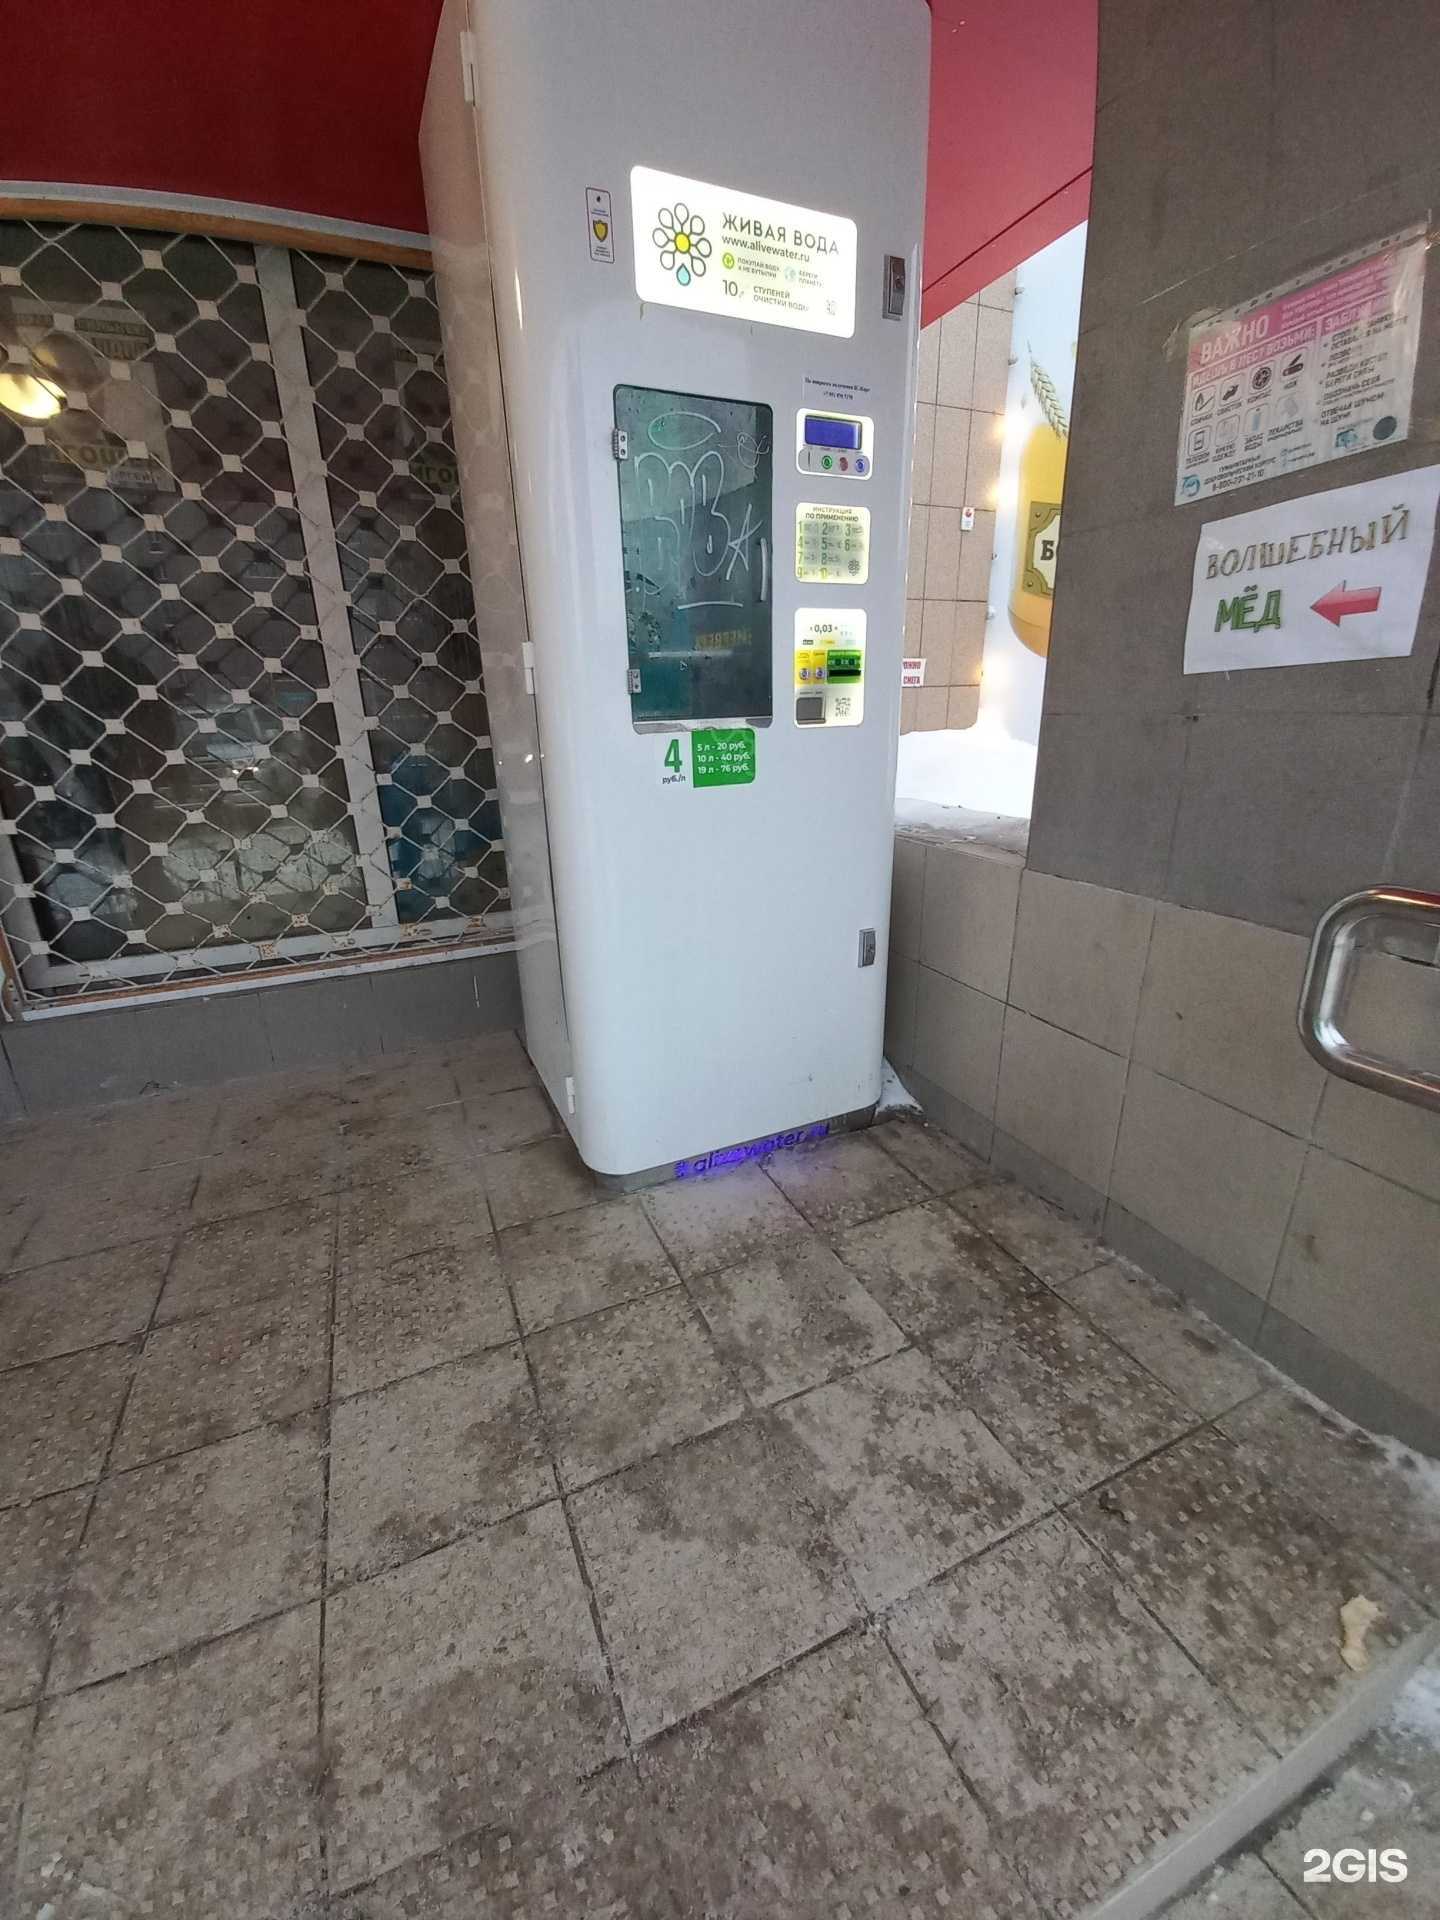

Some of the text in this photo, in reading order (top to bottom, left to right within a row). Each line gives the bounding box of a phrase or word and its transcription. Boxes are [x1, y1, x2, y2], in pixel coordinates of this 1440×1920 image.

[722, 212, 839, 255] ЖИВАЯ ВОДА
[721, 235, 810, 262] www.alivewater.ru
[722, 279, 738, 297] 10
[753, 285, 791, 299] СТУПЕНЕЙ
[753, 294, 787, 309] ОЧИСТКИ
[1201, 314, 1270, 364] ВАЖНО
[815, 513, 859, 522] ПРИМЕНЕНИЮ
[1206, 503, 1410, 580] ВОЛШЕБНЫЙ
[1214, 584, 1281, 633] МЁД
[814, 624, 833, 635] 0,03
[697, 743, 703, 752] 5
[717, 741, 728, 751] 20
[729, 740, 747, 752] руб.
[664, 738, 683, 773] 4
[720, 753, 732, 761] 40
[733, 751, 751, 762] руб.
[697, 766, 707, 774] 19
[720, 764, 731, 773] 76
[732, 763, 750, 773] руб.
[662, 774, 686, 785] руб./л
